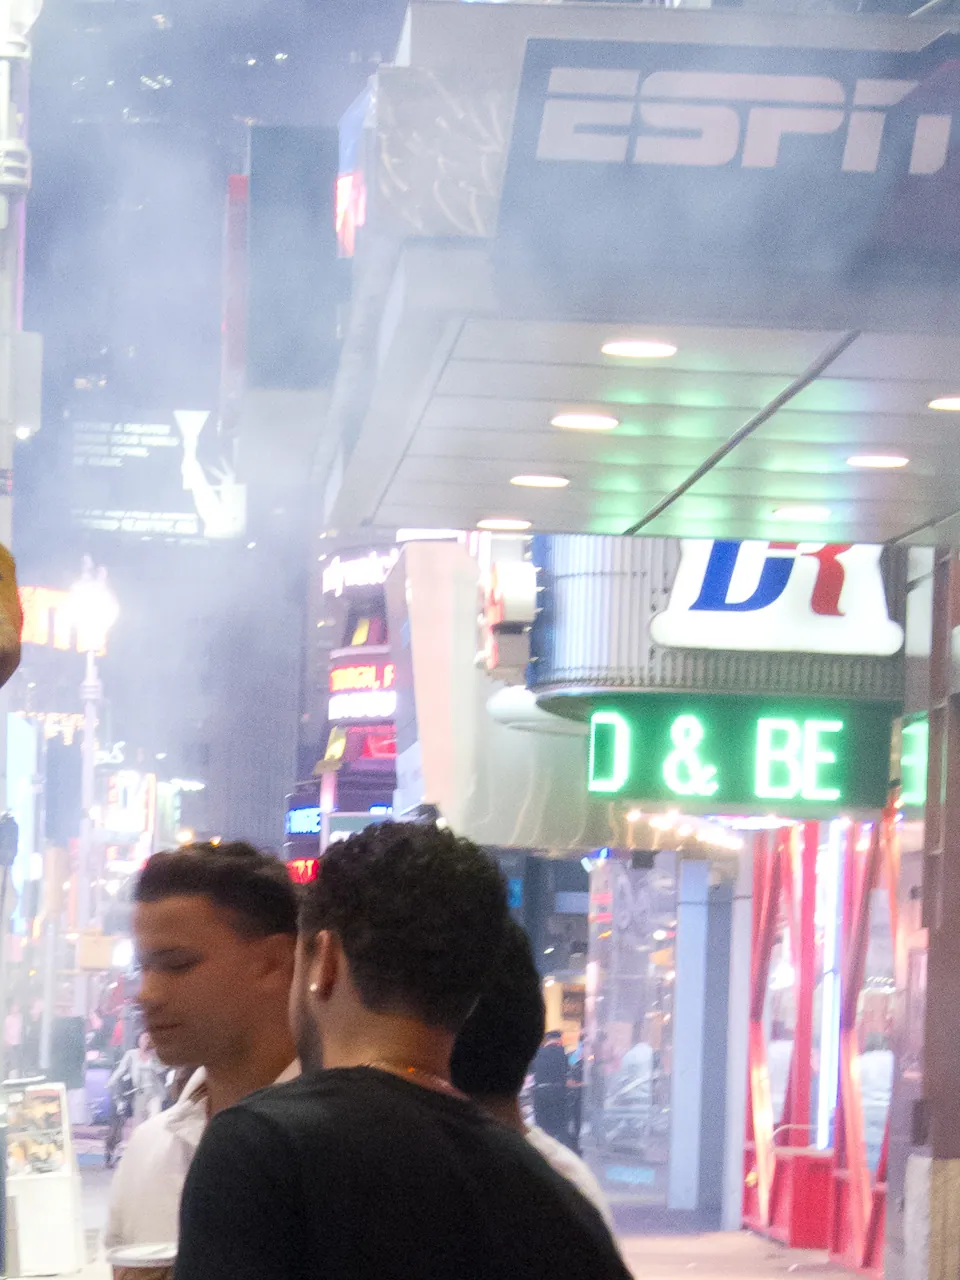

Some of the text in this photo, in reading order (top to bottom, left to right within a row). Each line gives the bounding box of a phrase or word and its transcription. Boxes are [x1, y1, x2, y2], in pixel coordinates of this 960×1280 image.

[537, 67, 952, 175] ESPN
[662, 714, 720, 797] &
[754, 717, 844, 801] BE
